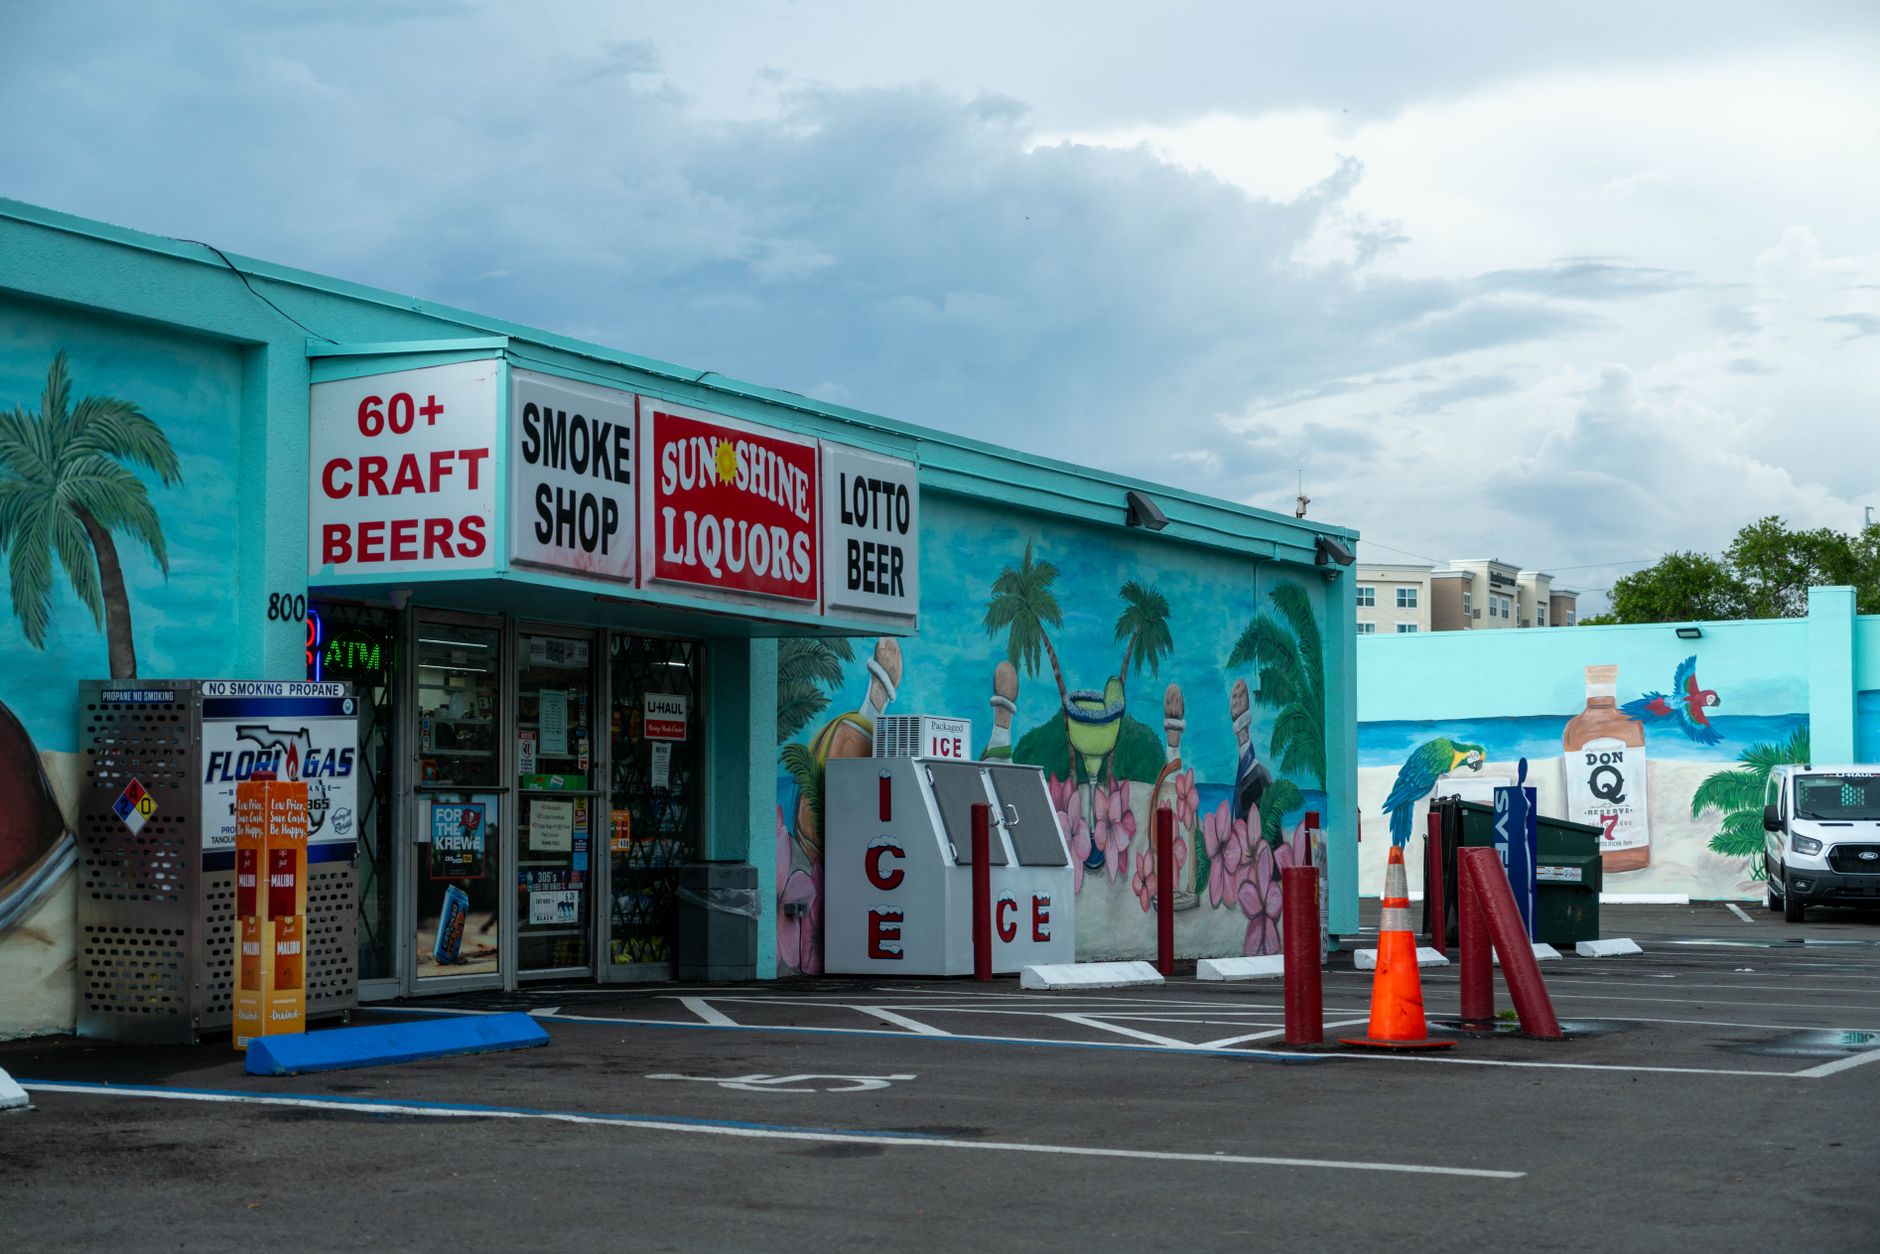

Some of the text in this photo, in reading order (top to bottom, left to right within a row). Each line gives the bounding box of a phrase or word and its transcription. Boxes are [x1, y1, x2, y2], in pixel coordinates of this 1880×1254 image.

[357, 392, 444, 437] 60+
[522, 402, 631, 485] SMOKE
[322, 447, 489, 499] CRAFT
[840, 472, 910, 535] LOTTO
[534, 483, 619, 556] SHOP
[322, 515, 487, 564] BEERS
[662, 506, 811, 584] LIQUORS
[847, 539, 905, 597] BEER
[267, 592, 306, 622] 800
[324, 640, 380, 669] ATM
[102, 691, 174, 701] PROPANE NO SMOKING
[209, 683, 340, 696] NO SMOKING PROPANE
[648, 701, 683, 714] U-HAUL
[931, 720, 964, 733] Packaged
[932, 736, 962, 758] ICE
[1586, 751, 1624, 765] DON
[129, 784, 138, 800] 4
[1587, 765, 1626, 805] Q
[121, 797, 128, 815] 2
[141, 797, 151, 815] 0
[271, 798, 285, 809] Low
[270, 810, 286, 823] Save
[436, 808, 462, 822] FOR
[270, 823, 280, 835] Be
[435, 822, 461, 836] THE
[1600, 814, 1619, 841] 7
[211, 836, 236, 844] TANQUE
[436, 836, 481, 850] KREWE
[864, 767, 906, 960] ICE
[238, 874, 256, 887] MALIBU
[271, 874, 294, 887] MALIBU
[537, 871, 557, 883] 305's
[995, 889, 1051, 943] CE
[277, 940, 301, 955] MALIBU
